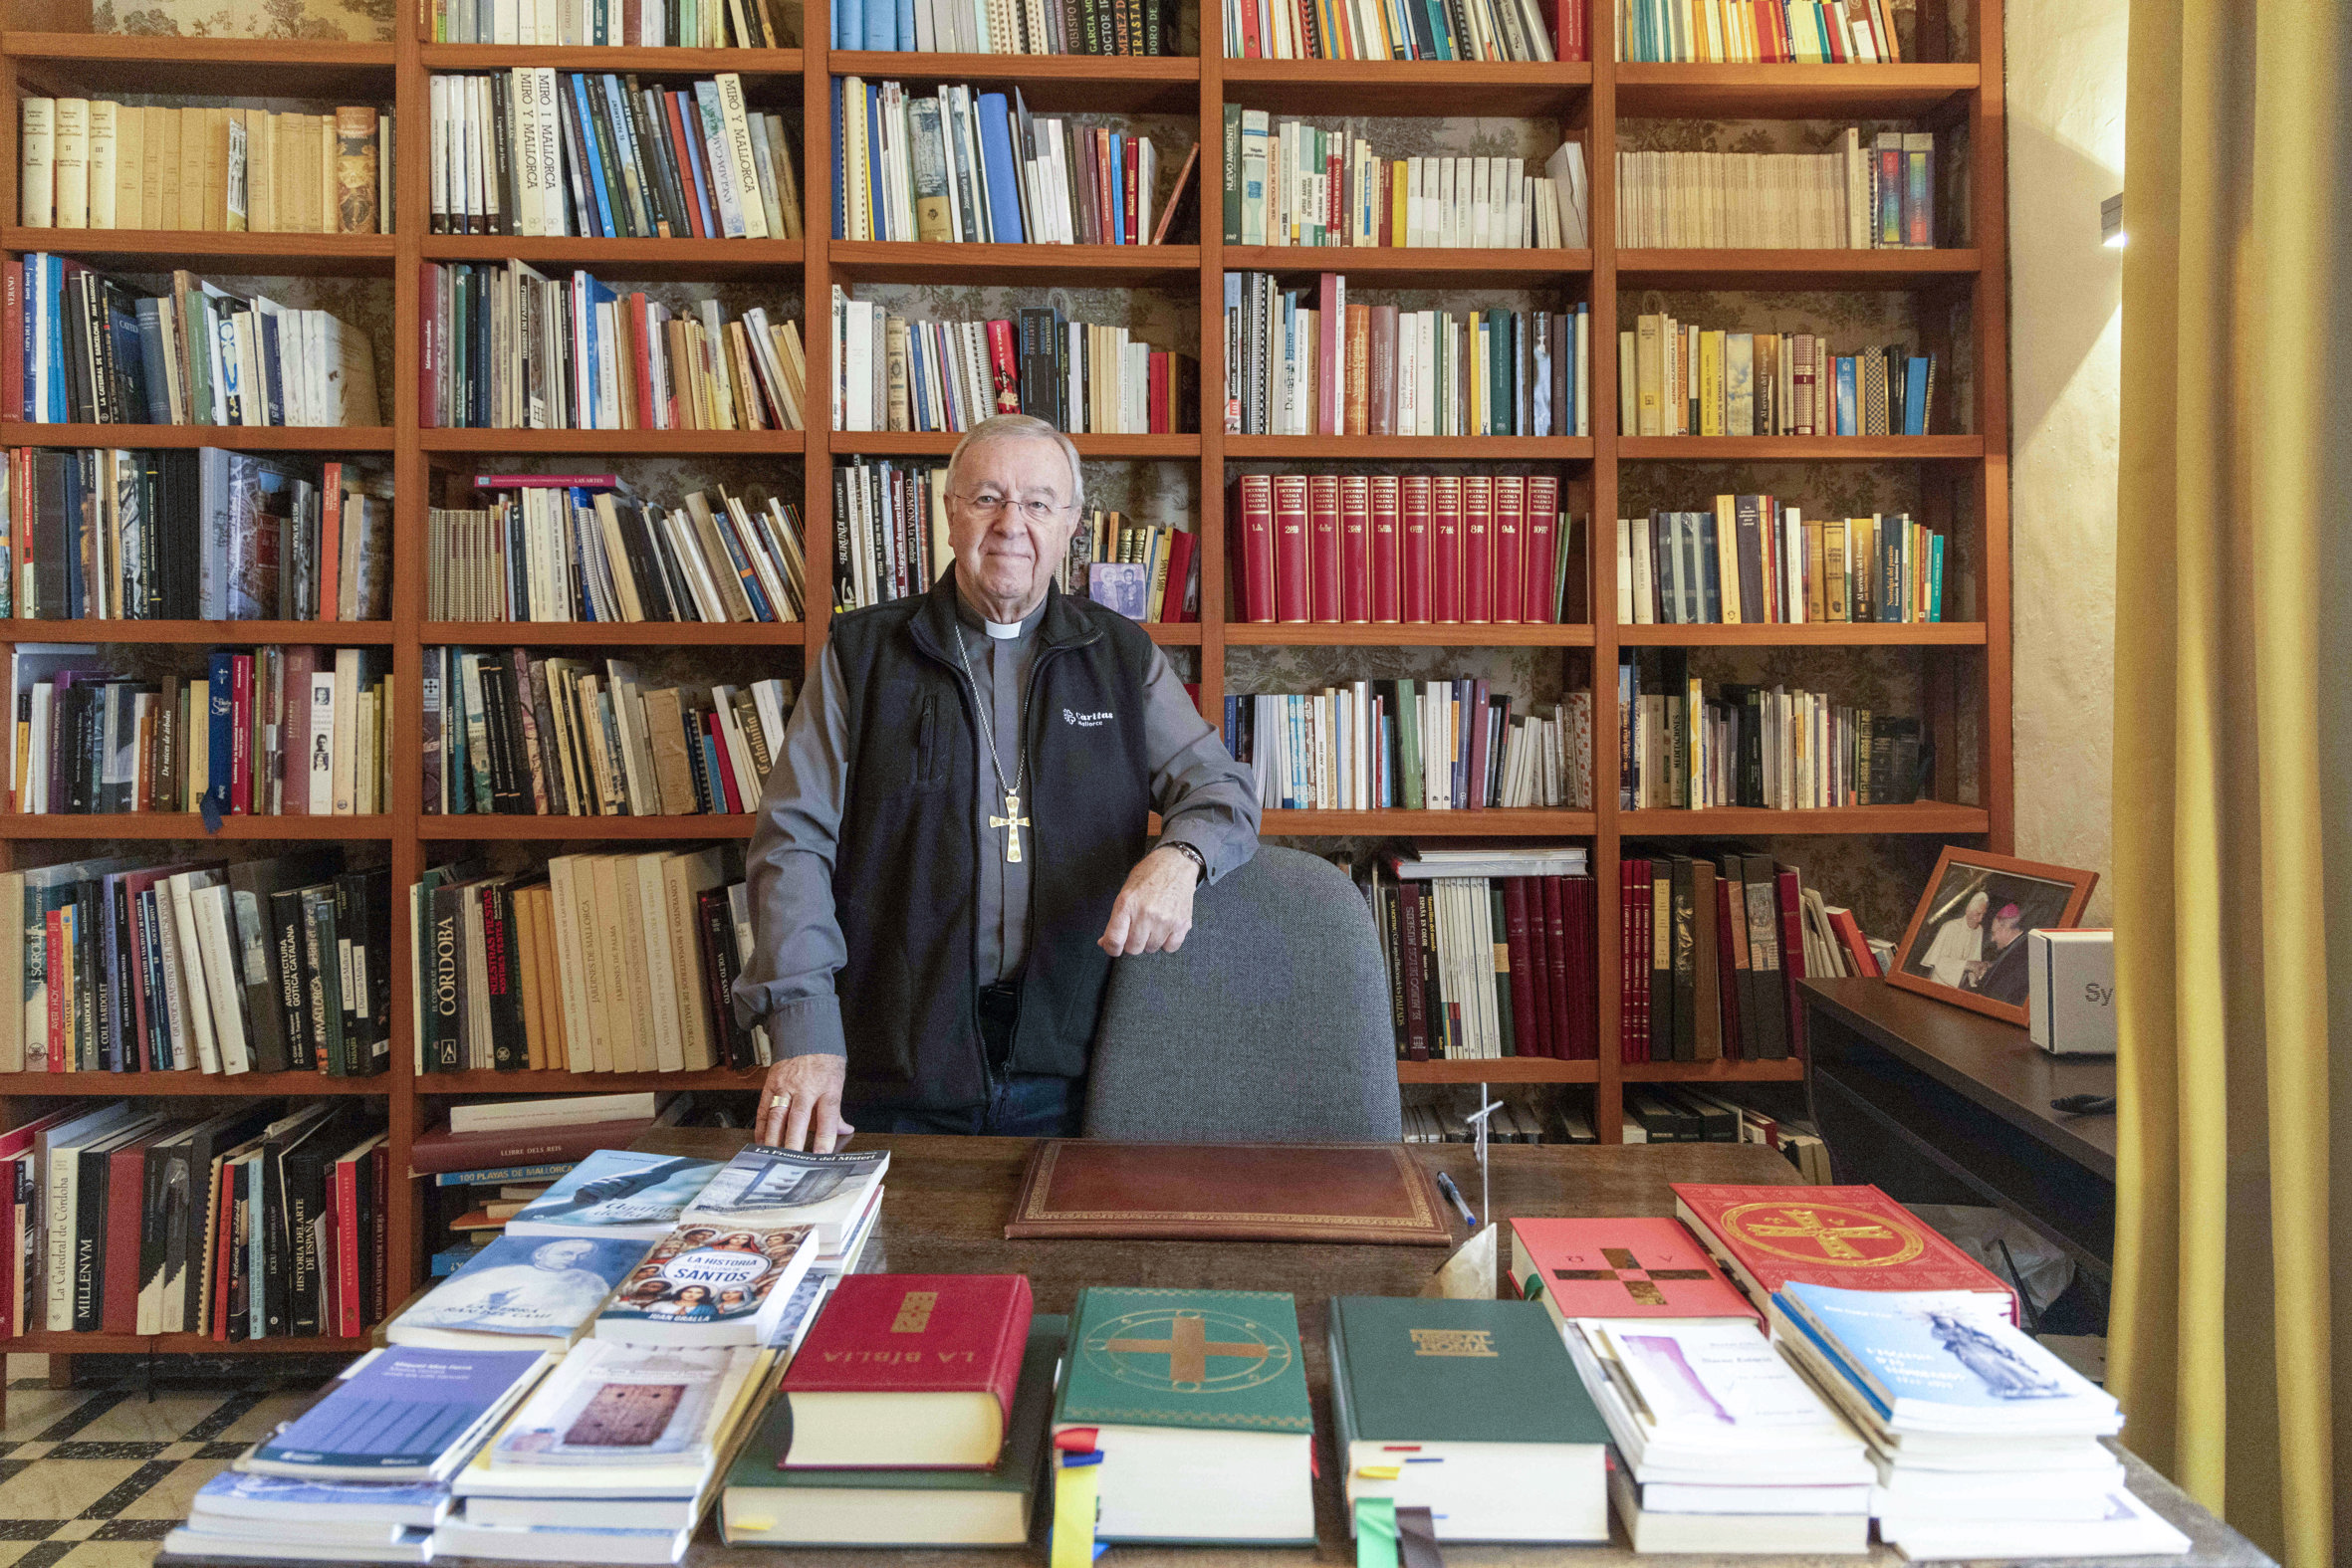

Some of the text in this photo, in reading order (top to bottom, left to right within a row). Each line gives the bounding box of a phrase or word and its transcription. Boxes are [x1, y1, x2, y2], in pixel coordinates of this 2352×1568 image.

[520, 74, 536, 105] MIRÓ
[539, 75, 554, 106] MIRÓ
[524, 123, 540, 190] MALLORCA
[542, 124, 557, 190] MALLORCA
[724, 81, 742, 111] MIRÓ
[733, 128, 756, 194] MALLORCA
[92, 322, 102, 356] BARCELONA
[97, 366, 106, 396] CATEDRAL
[905, 478, 916, 529] CREMONA
[835, 520, 849, 565] BURUNDI
[29, 924, 43, 977] SOROLLA
[286, 924, 298, 972] CATALANA
[436, 916, 456, 1016] CÓRDOBA
[482, 889, 499, 996] NUESTRAS FIESTAS
[280, 939, 293, 1008] ARQUITECTURA
[716, 952, 731, 1004] VOLTO SANTO
[83, 991, 93, 1033] BARDOLET
[99, 983, 110, 1045] COLL BARDOLET
[476, 1171, 509, 1181] PLAYAS
[526, 1165, 575, 1177] MALLORCA
[771, 1149, 819, 1163] Frontera
[294, 1199, 305, 1227] ARTE
[52, 1177, 69, 1302] La Catedral de Córdoba
[303, 1218, 315, 1271] DE ESPAÑA
[685, 1254, 758, 1267] LA HISTORIA
[77, 1238, 94, 1319] MILLENVM
[294, 1245, 305, 1291] HISTORIA
[673, 1267, 751, 1283] SANTOS
[938, 1351, 976, 1365] LA
